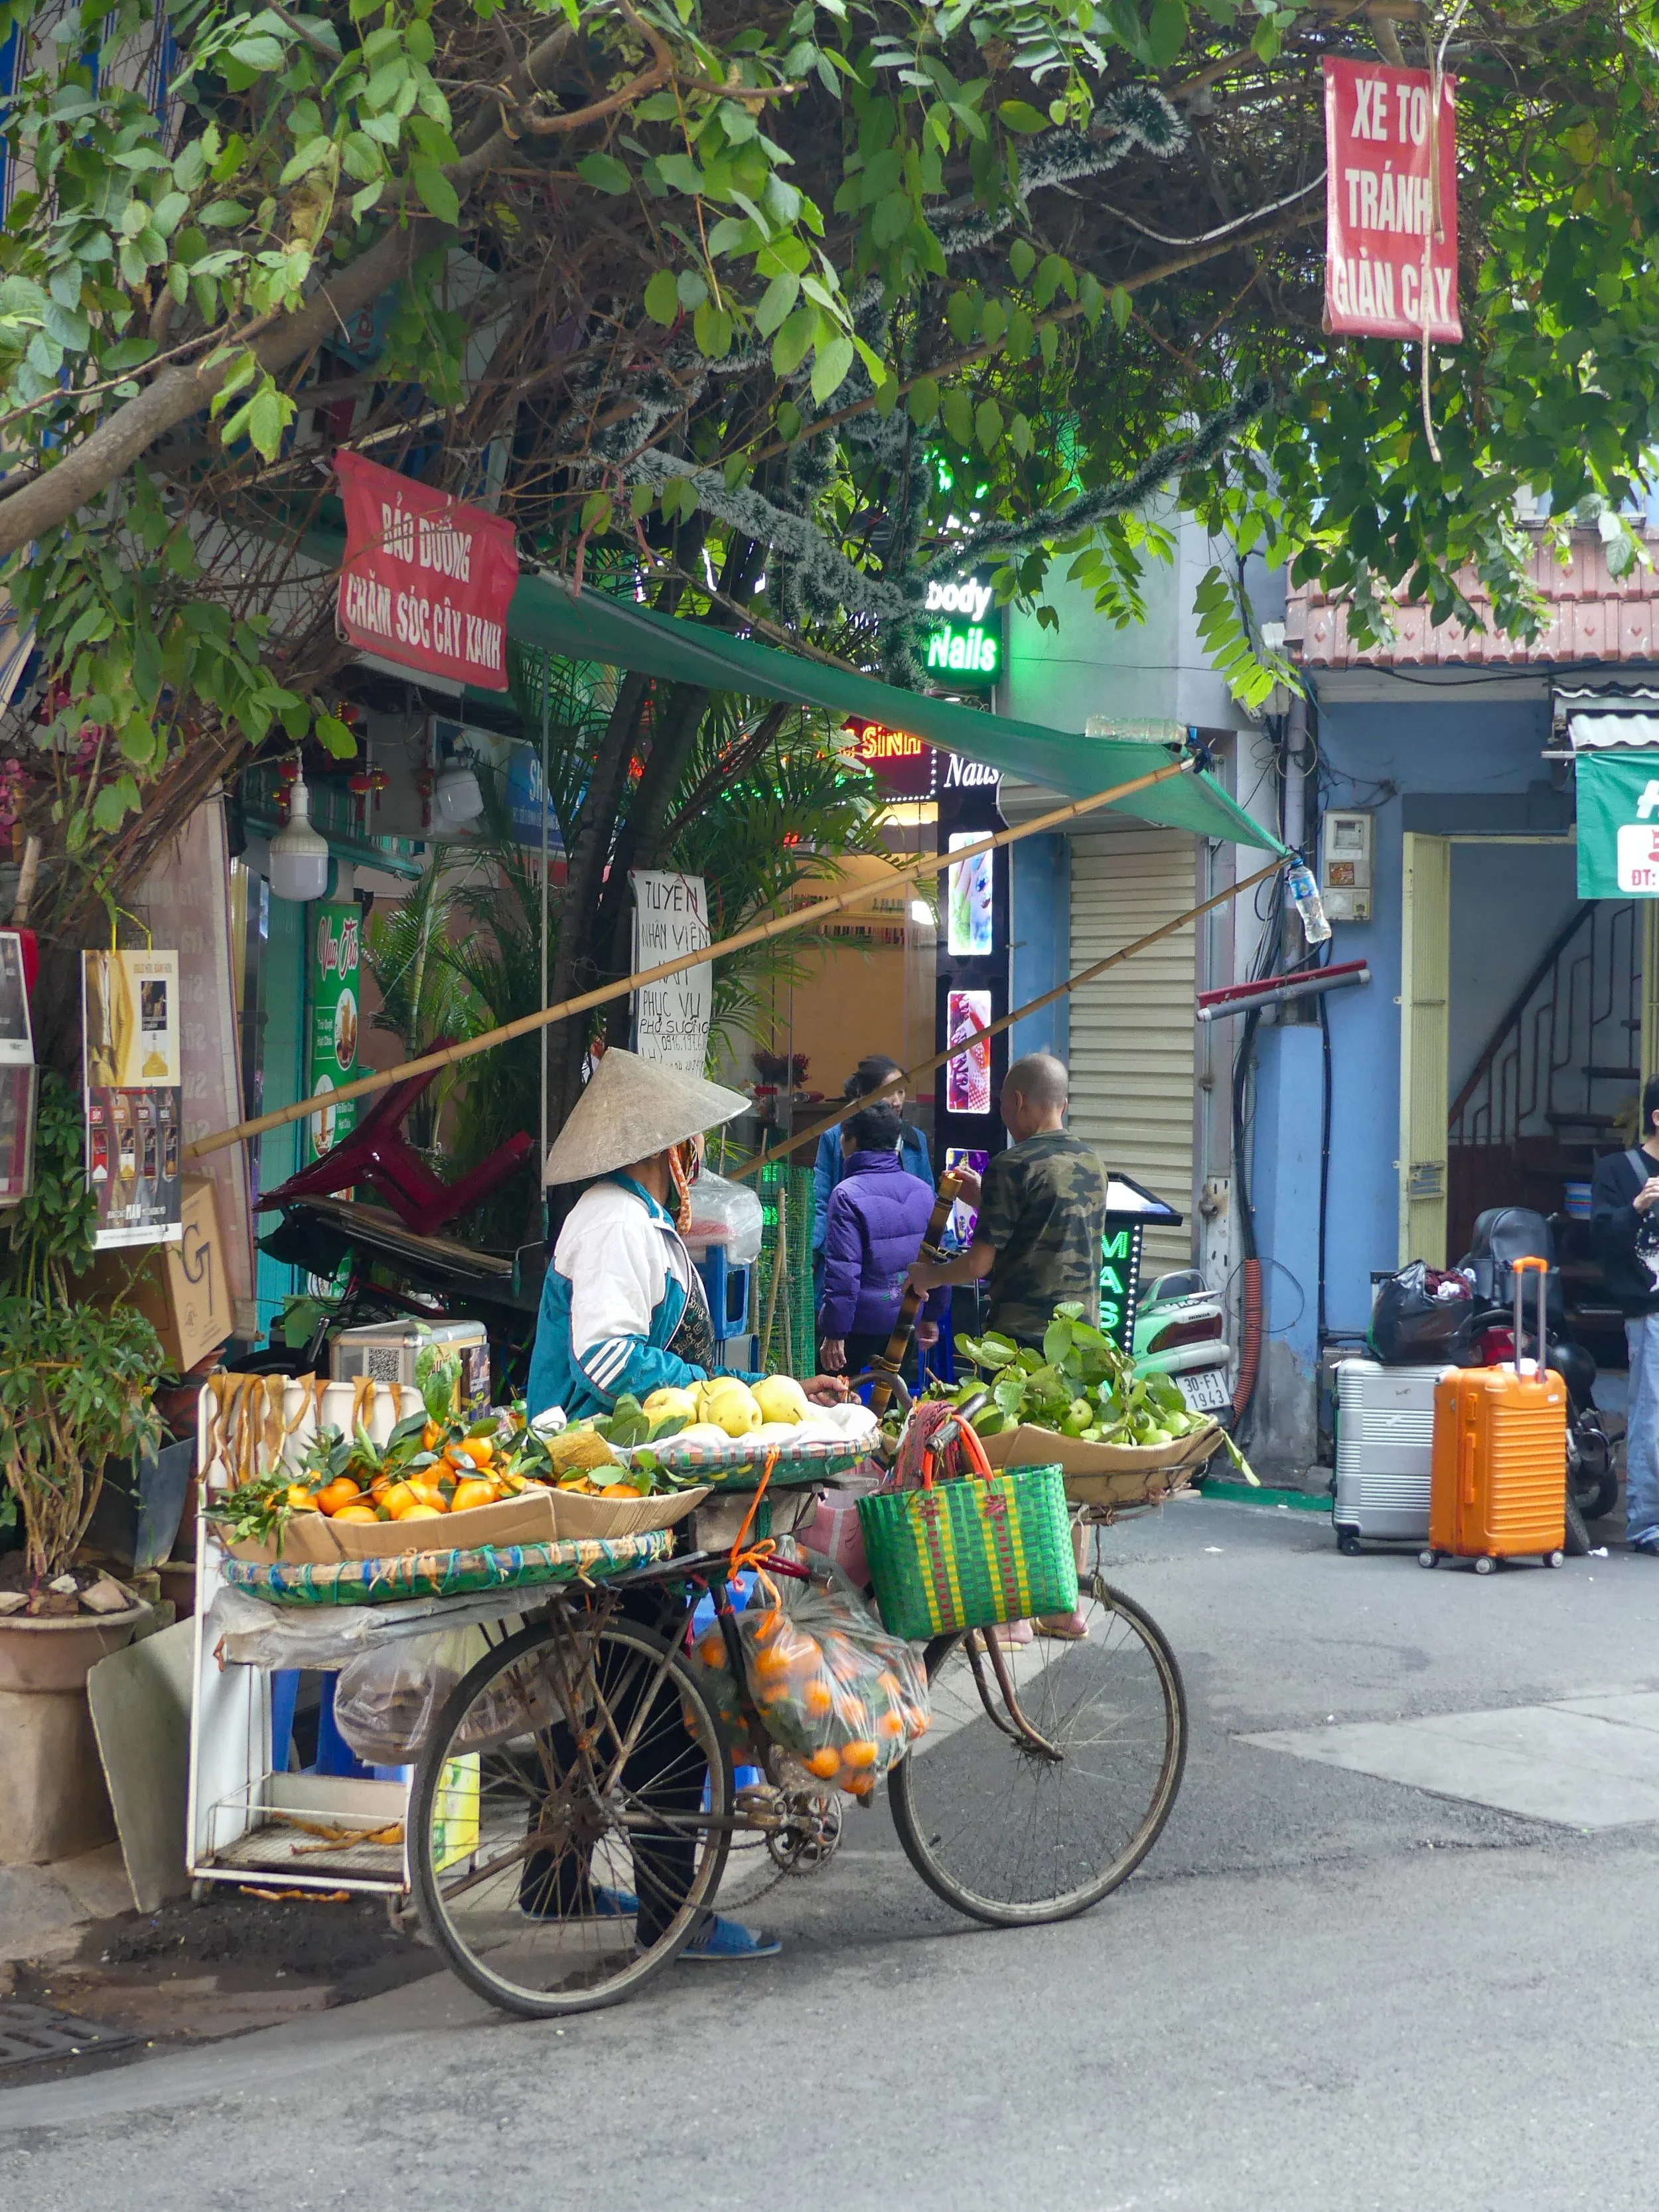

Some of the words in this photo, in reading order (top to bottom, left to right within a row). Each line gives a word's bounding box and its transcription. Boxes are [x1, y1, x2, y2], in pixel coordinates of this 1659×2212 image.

[1350, 78, 1388, 141] XE
[1396, 84, 1427, 147] TO
[1344, 159, 1431, 235] TRÁNH
[1332, 246, 1396, 322] GIÀN
[382, 490, 414, 563] BẢO
[346, 569, 393, 637] CHĂM
[396, 585, 430, 649] SÓC
[433, 597, 461, 658] CÂY
[466, 613, 502, 670] XANH
[925, 577, 993, 622] body
[928, 625, 997, 672] Nails
[642, 919, 666, 950] NHÂN
[672, 921, 708, 952] VIÊN
[1189, 1312, 1210, 1321] HONDA
[1184, 1373, 1218, 1393] 30-F1
[1190, 1390, 1224, 1409] 1943
